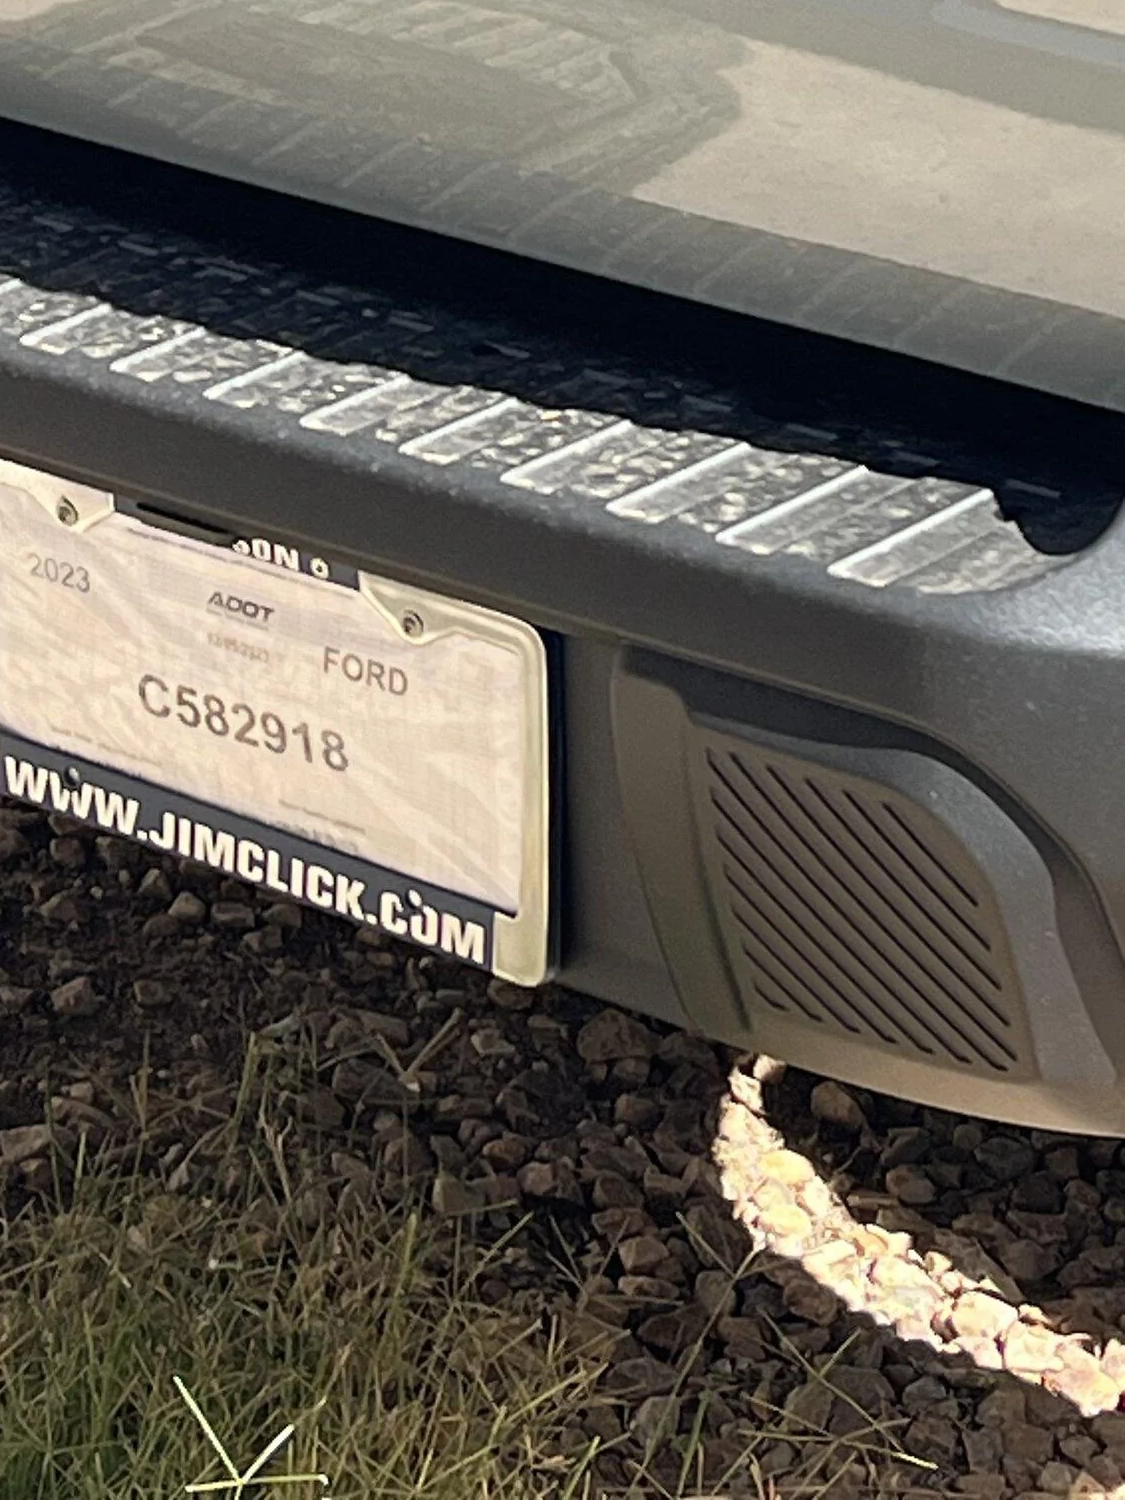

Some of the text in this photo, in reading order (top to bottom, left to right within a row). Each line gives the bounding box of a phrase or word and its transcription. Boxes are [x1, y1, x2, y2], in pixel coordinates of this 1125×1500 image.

[27, 552, 91, 594] 2023
[207, 591, 275, 622] ADOT
[322, 646, 409, 697] FORD
[137, 673, 350, 772] C582918
[4, 755, 488, 964] WWW.JIMCLICK.COM
